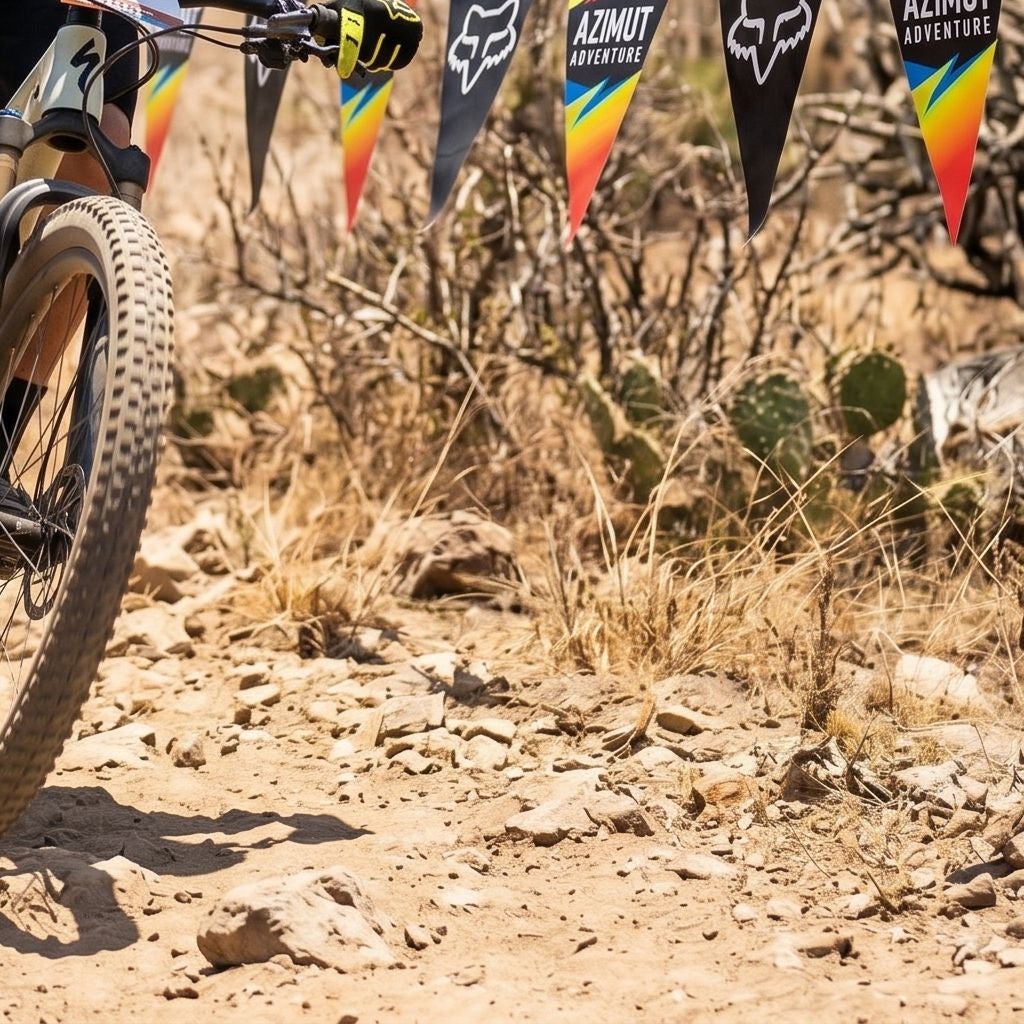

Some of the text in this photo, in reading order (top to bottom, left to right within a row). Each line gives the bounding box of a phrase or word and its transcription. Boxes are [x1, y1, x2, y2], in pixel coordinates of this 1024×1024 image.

[572, 5, 655, 46] AZIMUT
[903, 15, 991, 46] ADVENTURE
[569, 46, 643, 67] ADVENTURE
